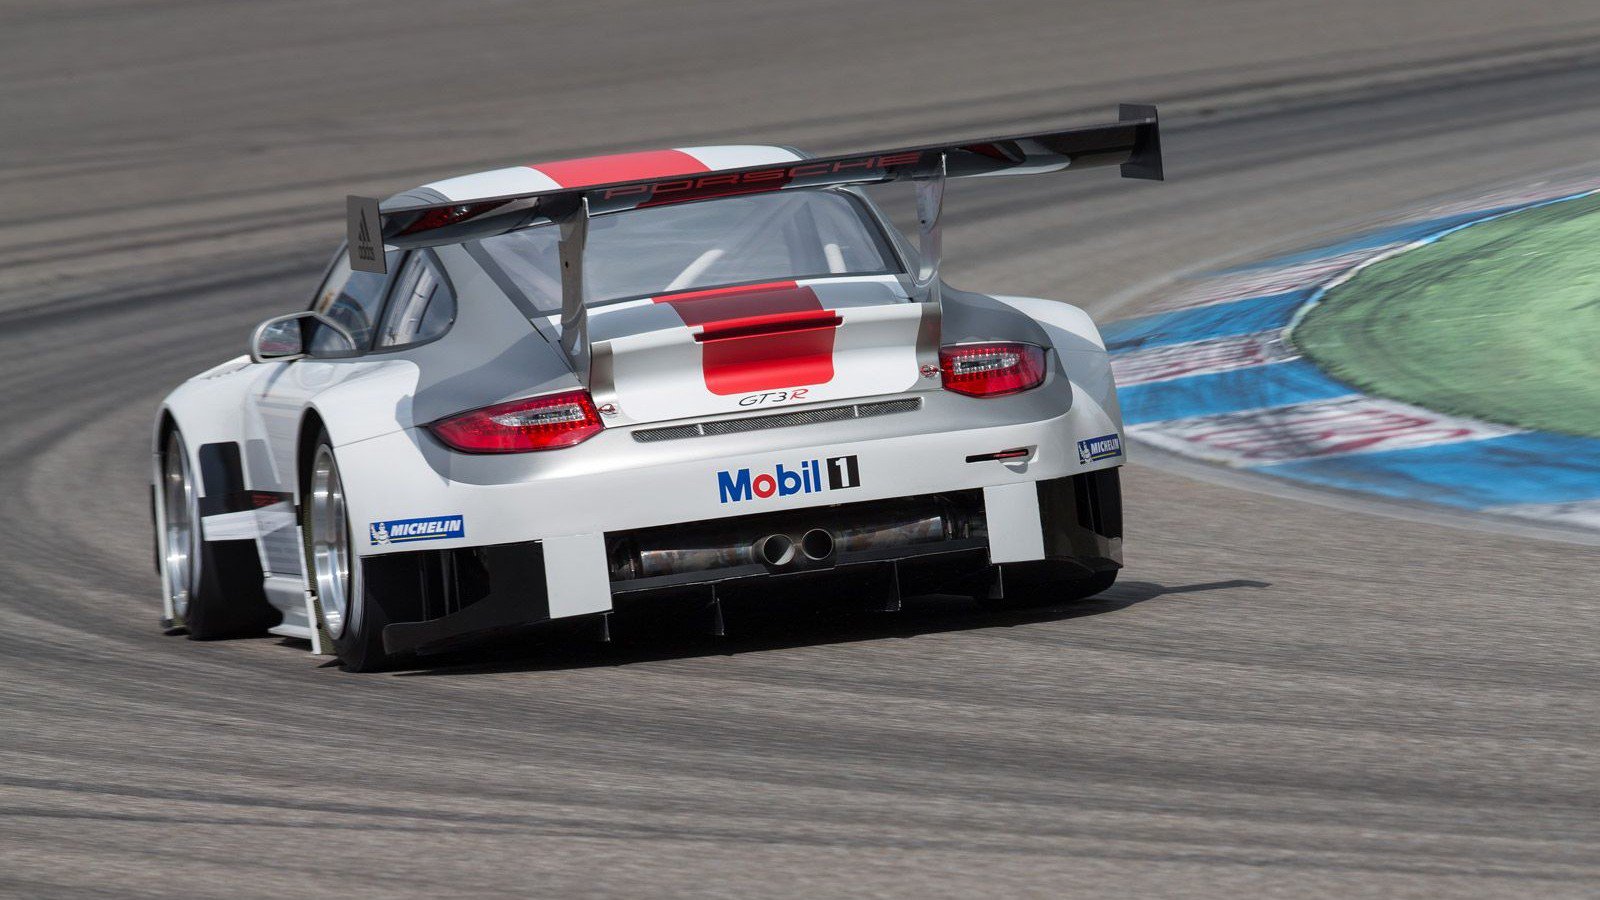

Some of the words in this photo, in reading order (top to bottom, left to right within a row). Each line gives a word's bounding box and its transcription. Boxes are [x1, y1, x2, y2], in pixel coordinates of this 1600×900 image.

[604, 151, 921, 200] PORSCHE
[717, 459, 821, 504] Mobil
[390, 519, 462, 537] MICHELIN
